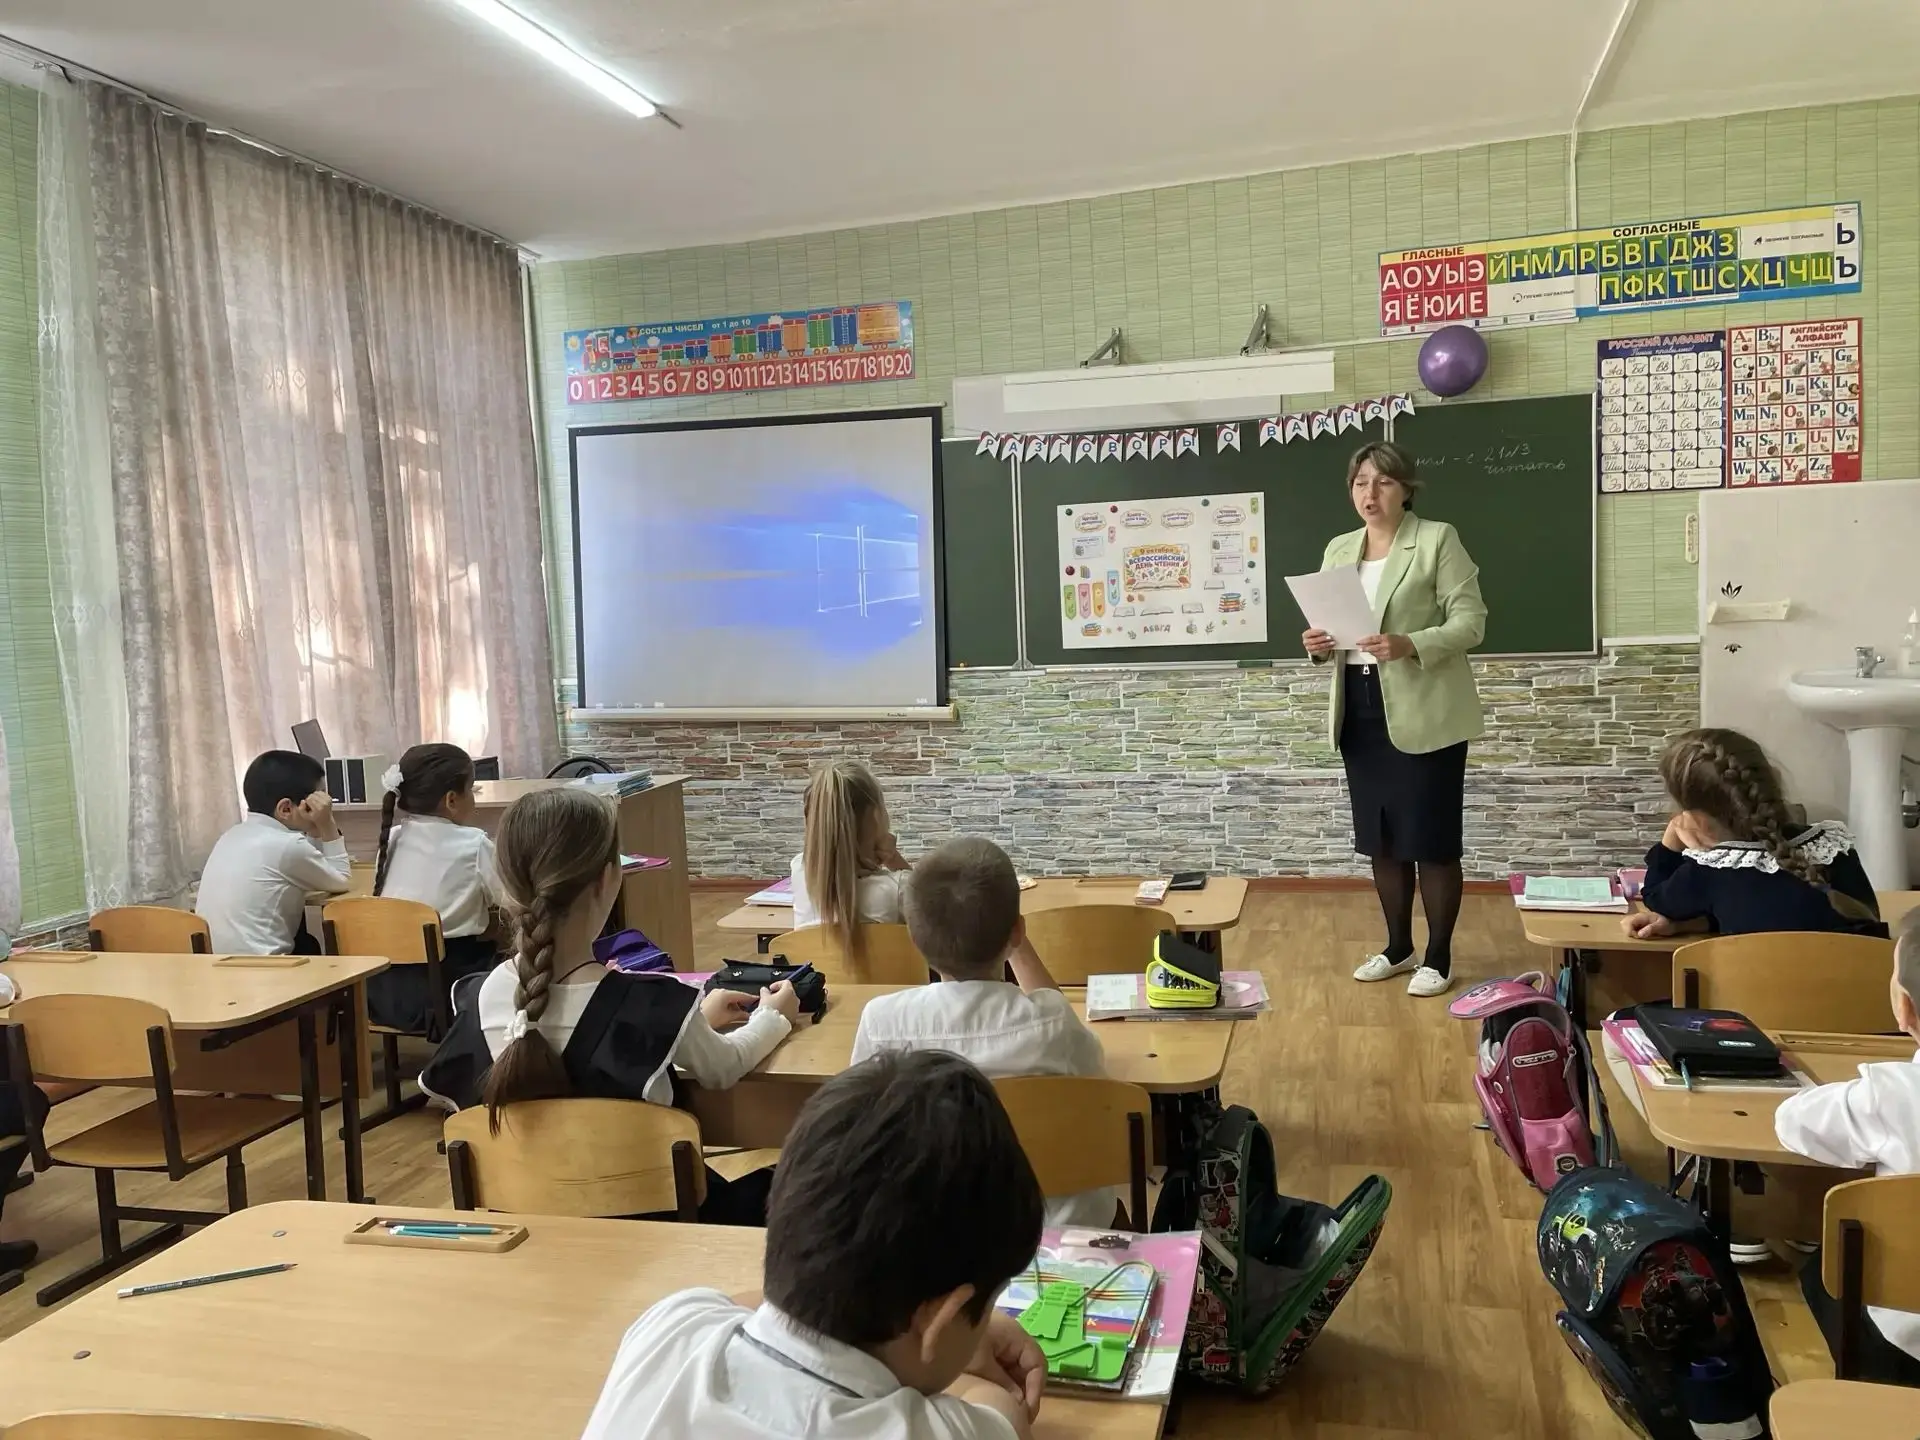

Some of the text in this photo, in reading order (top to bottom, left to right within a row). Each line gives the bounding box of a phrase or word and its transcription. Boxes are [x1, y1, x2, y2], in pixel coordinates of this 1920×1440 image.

[1613, 221, 1700, 238] СОГЛАСНЫЕ
[1402, 246, 1465, 262] ГЛАСНЫЕ
[639, 326, 673, 336] СОСТАВ
[674, 323, 704, 333] ЧИСЕЛ
[741, 318, 751, 326] 10
[1790, 322, 1848, 334] АНГЛИЙСКИЙ
[1608, 333, 1714, 350] РУССКИЙ АЛФАВИТ
[1795, 332, 1843, 342] АЛФАВИТ
[570, 354, 912, 400] 0 1 2 3 4 5 6 7 8 9 10 11 12 13 14 15 16 17 18 19 20
[986, 400, 1406, 452] РАЗГОВОРЫ О ВАЖНОМ
[1129, 554, 1185, 565] ВСЕРОССИЙСКИЙ
[1136, 562, 1153, 570] ДЕНЬ
